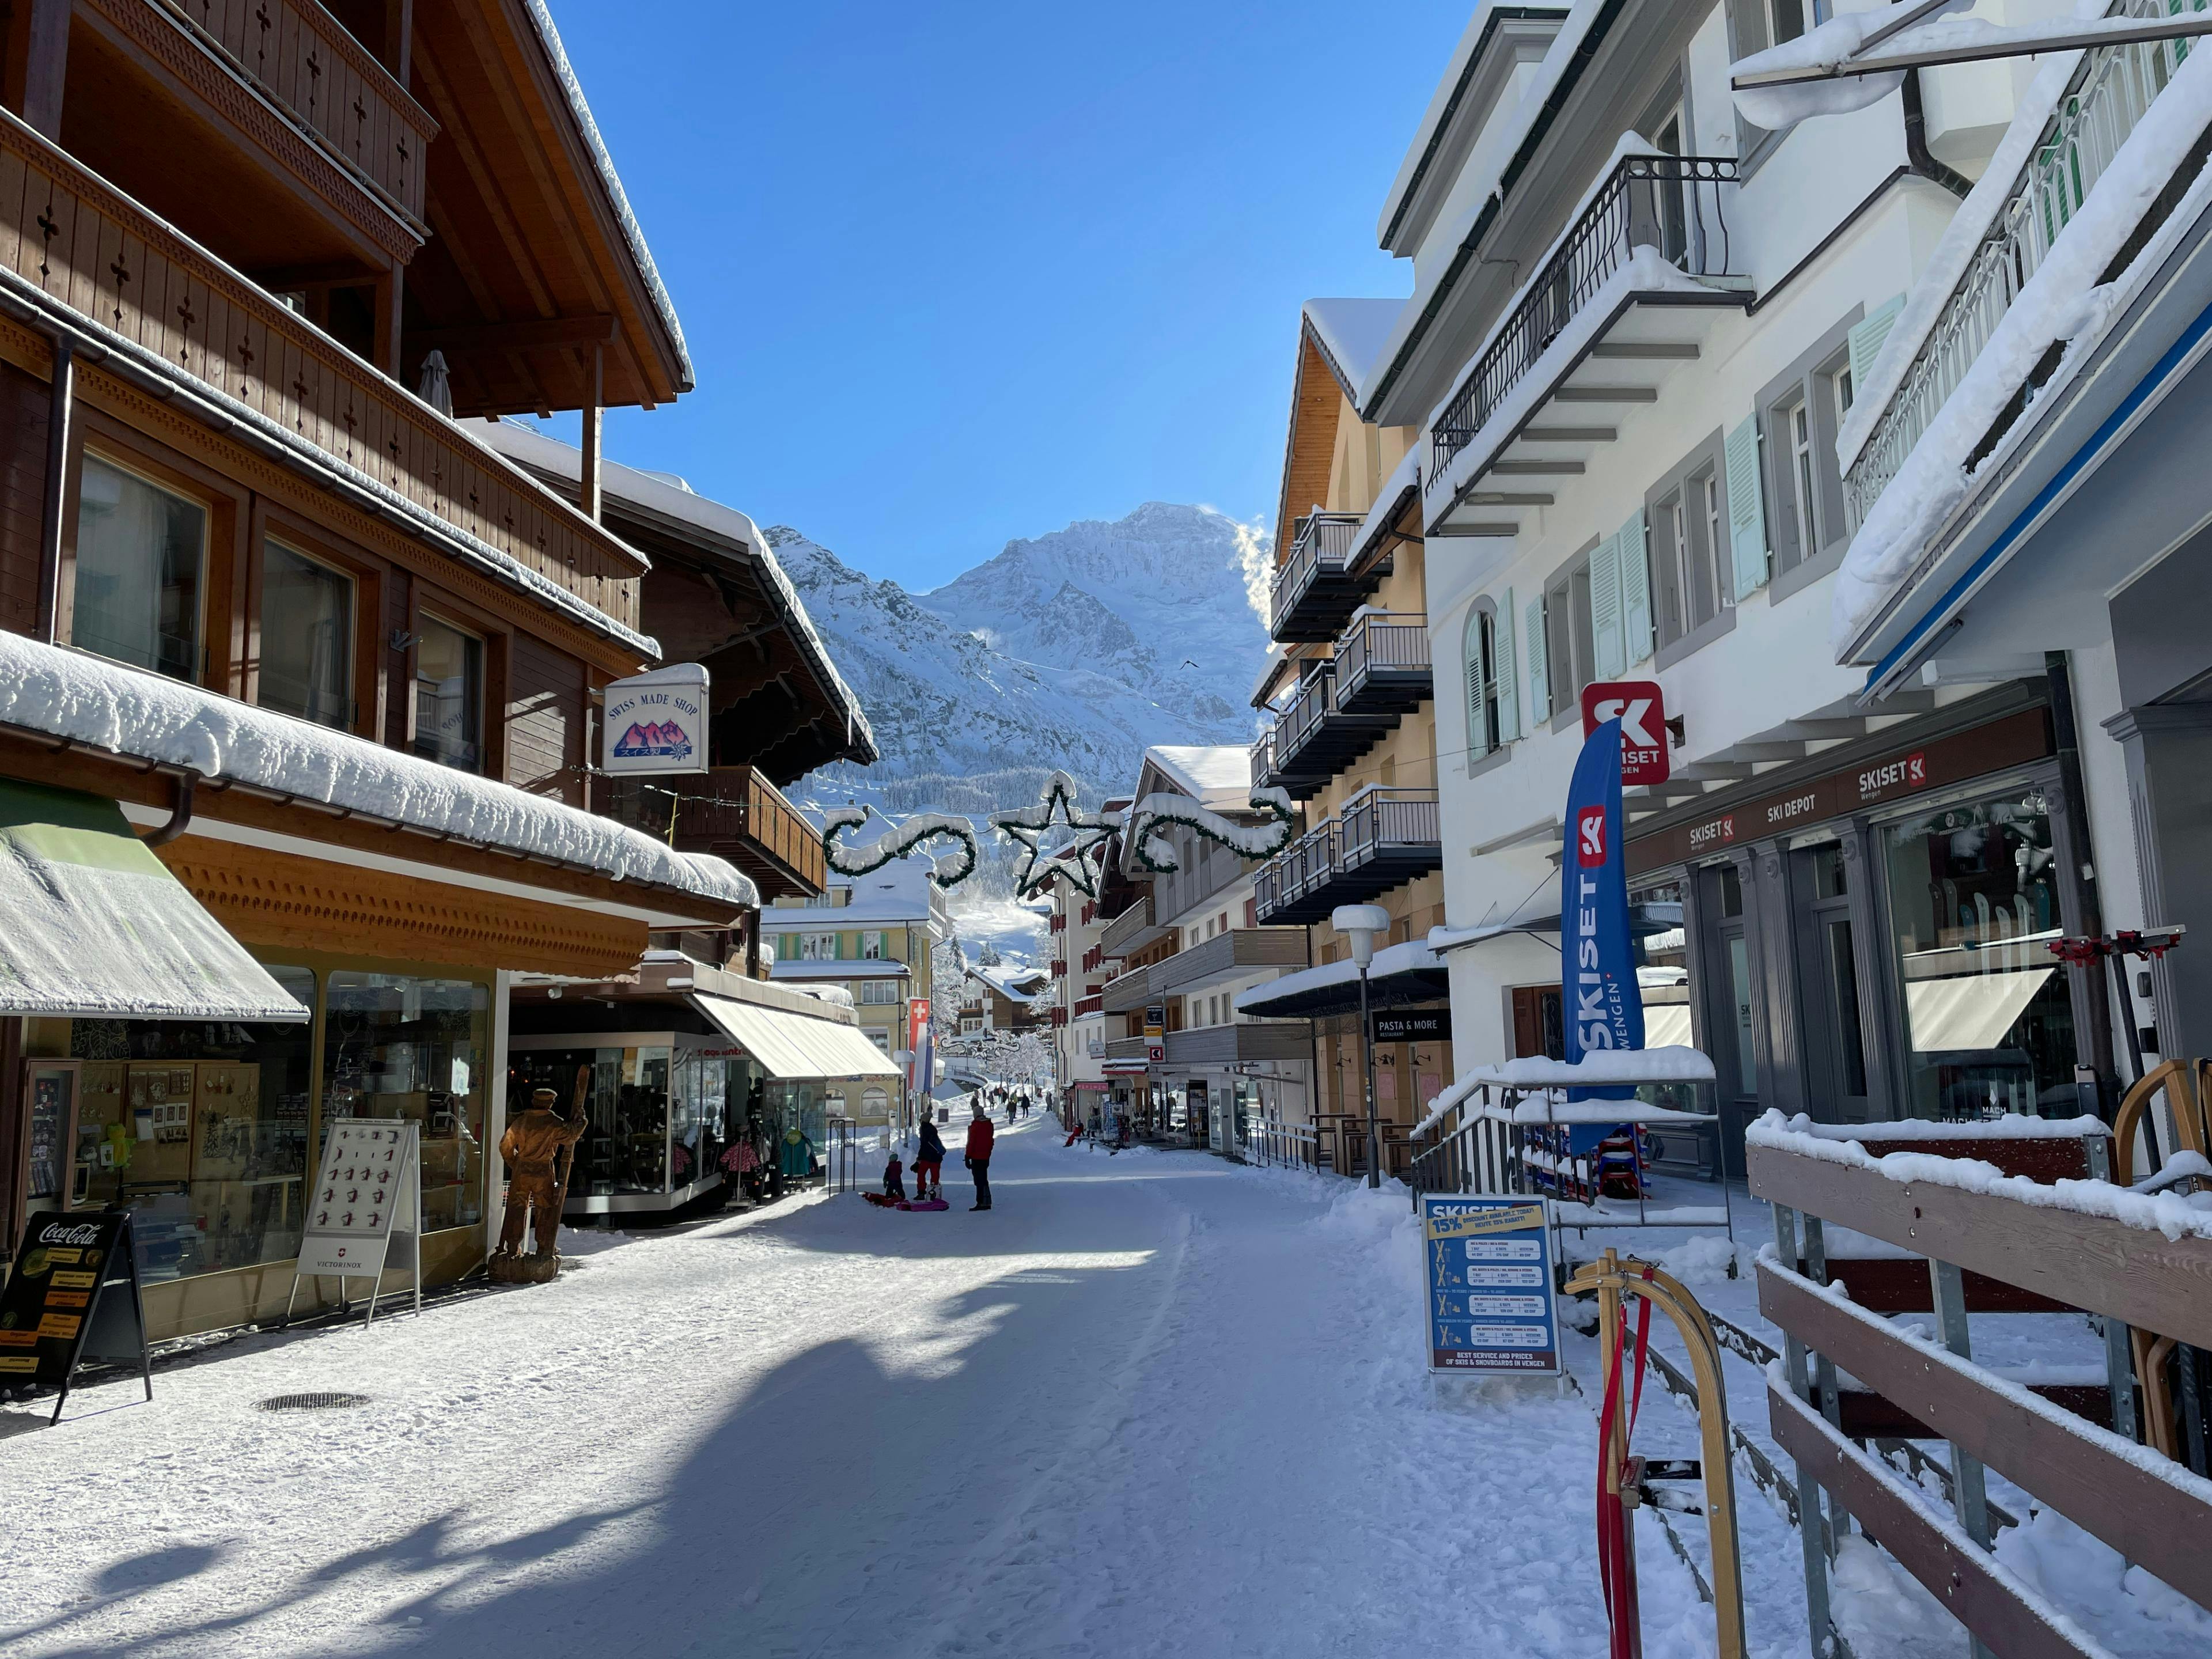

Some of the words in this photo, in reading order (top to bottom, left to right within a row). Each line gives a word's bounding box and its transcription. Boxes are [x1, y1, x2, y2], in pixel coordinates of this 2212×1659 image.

[608, 698, 635, 720] SWISS
[641, 694, 669, 706] MADE
[673, 697, 698, 717] SHOP
[620, 747, 661, 756] スイス製
[1622, 751, 1660, 764] ISET
[1859, 760, 1907, 792] SKISET
[1861, 790, 1881, 801] Wengen
[1767, 804, 1783, 823] SKI
[1785, 794, 1815, 818] DEPOT
[1690, 820, 1722, 844] SKISET
[1578, 874, 1613, 1050] SKISET
[1379, 1021, 1404, 1031] PASTA
[1406, 1021, 1412, 1030] &
[1414, 1020, 1437, 1029] MORE
[1607, 983, 1631, 1050] WENGEN
[1982, 1106, 2006, 1115] MACH
[1432, 1217, 1463, 1233] 15%
[1463, 1214, 1488, 1224] DISCOUNT
[1489, 1210, 1516, 1219] AVAILABLE
[39, 1222, 104, 1245] Coca-Cola
